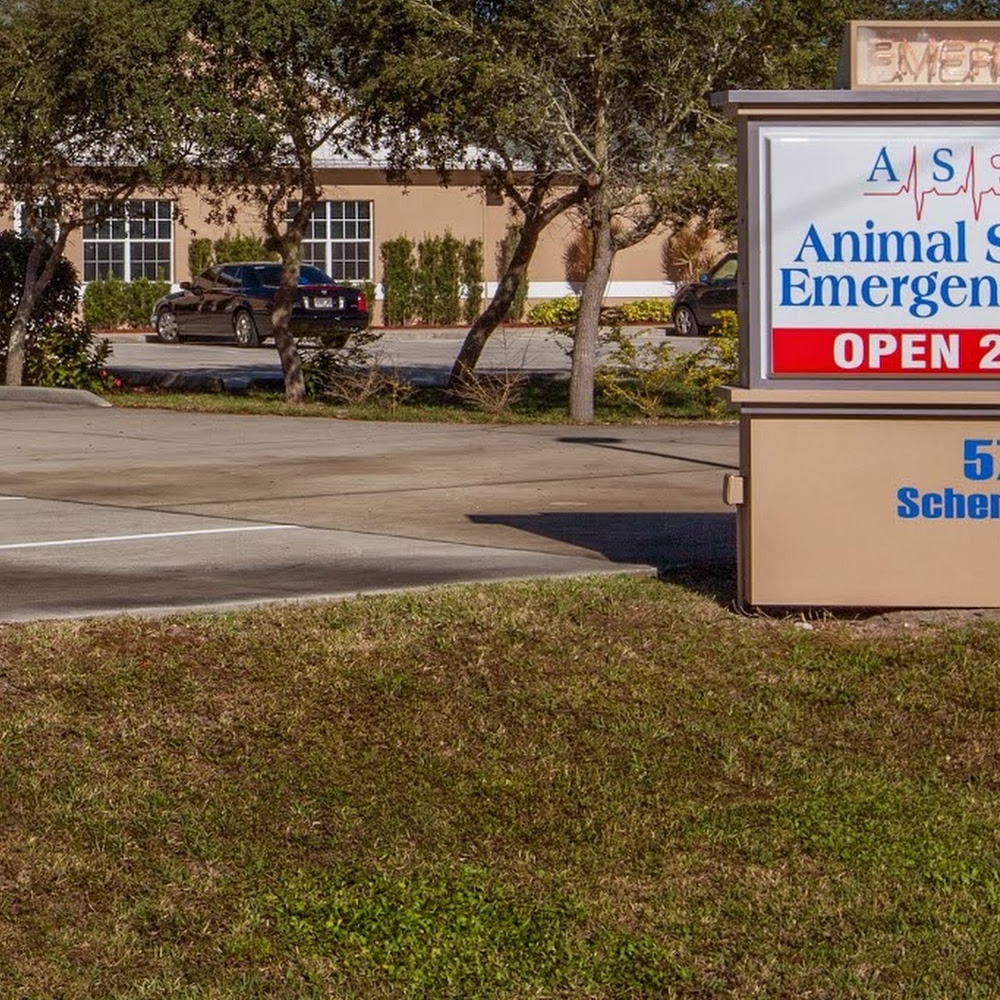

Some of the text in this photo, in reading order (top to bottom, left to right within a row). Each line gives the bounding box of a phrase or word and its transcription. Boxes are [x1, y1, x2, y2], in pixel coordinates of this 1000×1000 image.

[794, 219, 968, 263] Animal
[780, 267, 1000, 318] Emergen
[833, 333, 960, 370] OPEN
[963, 439, 1000, 481] 5
